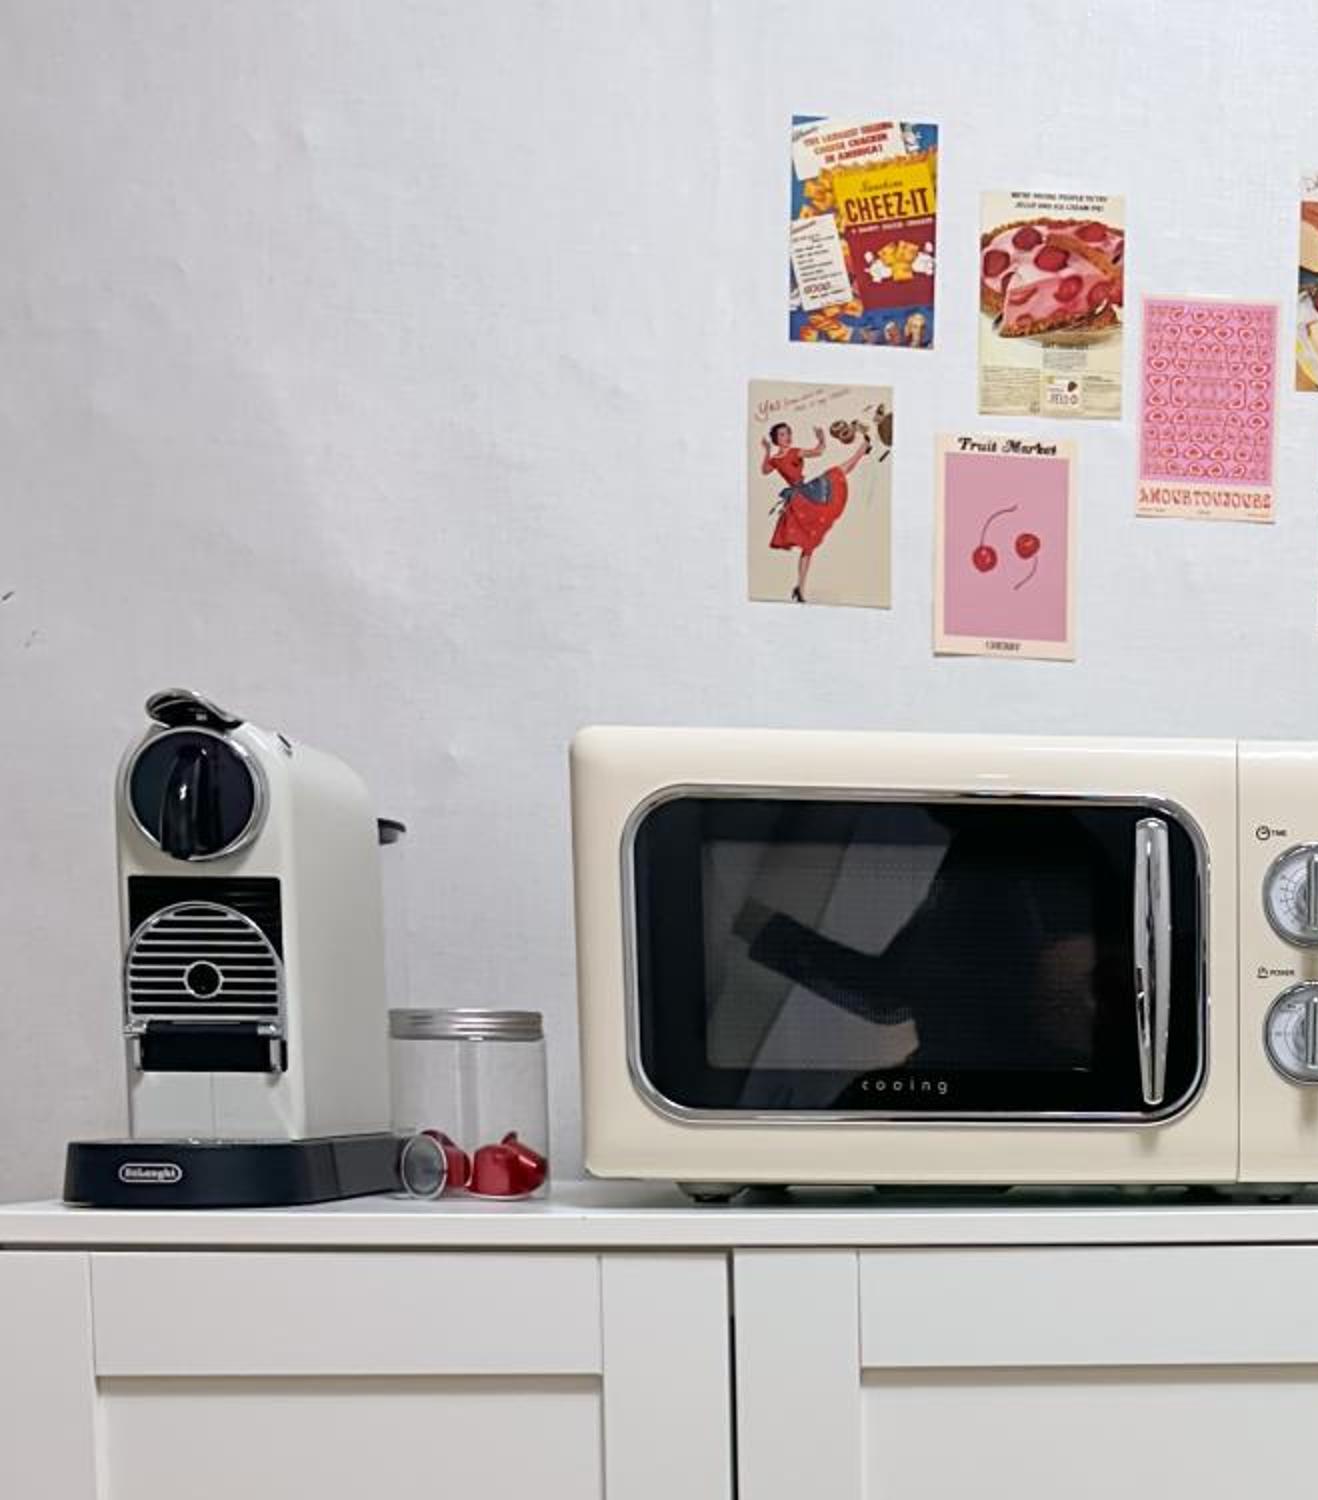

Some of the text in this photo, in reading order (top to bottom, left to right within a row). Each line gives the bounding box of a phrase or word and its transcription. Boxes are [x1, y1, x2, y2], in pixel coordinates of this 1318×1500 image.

[957, 437, 1057, 455] Fruit Market
[861, 1076, 949, 1096] cooing
